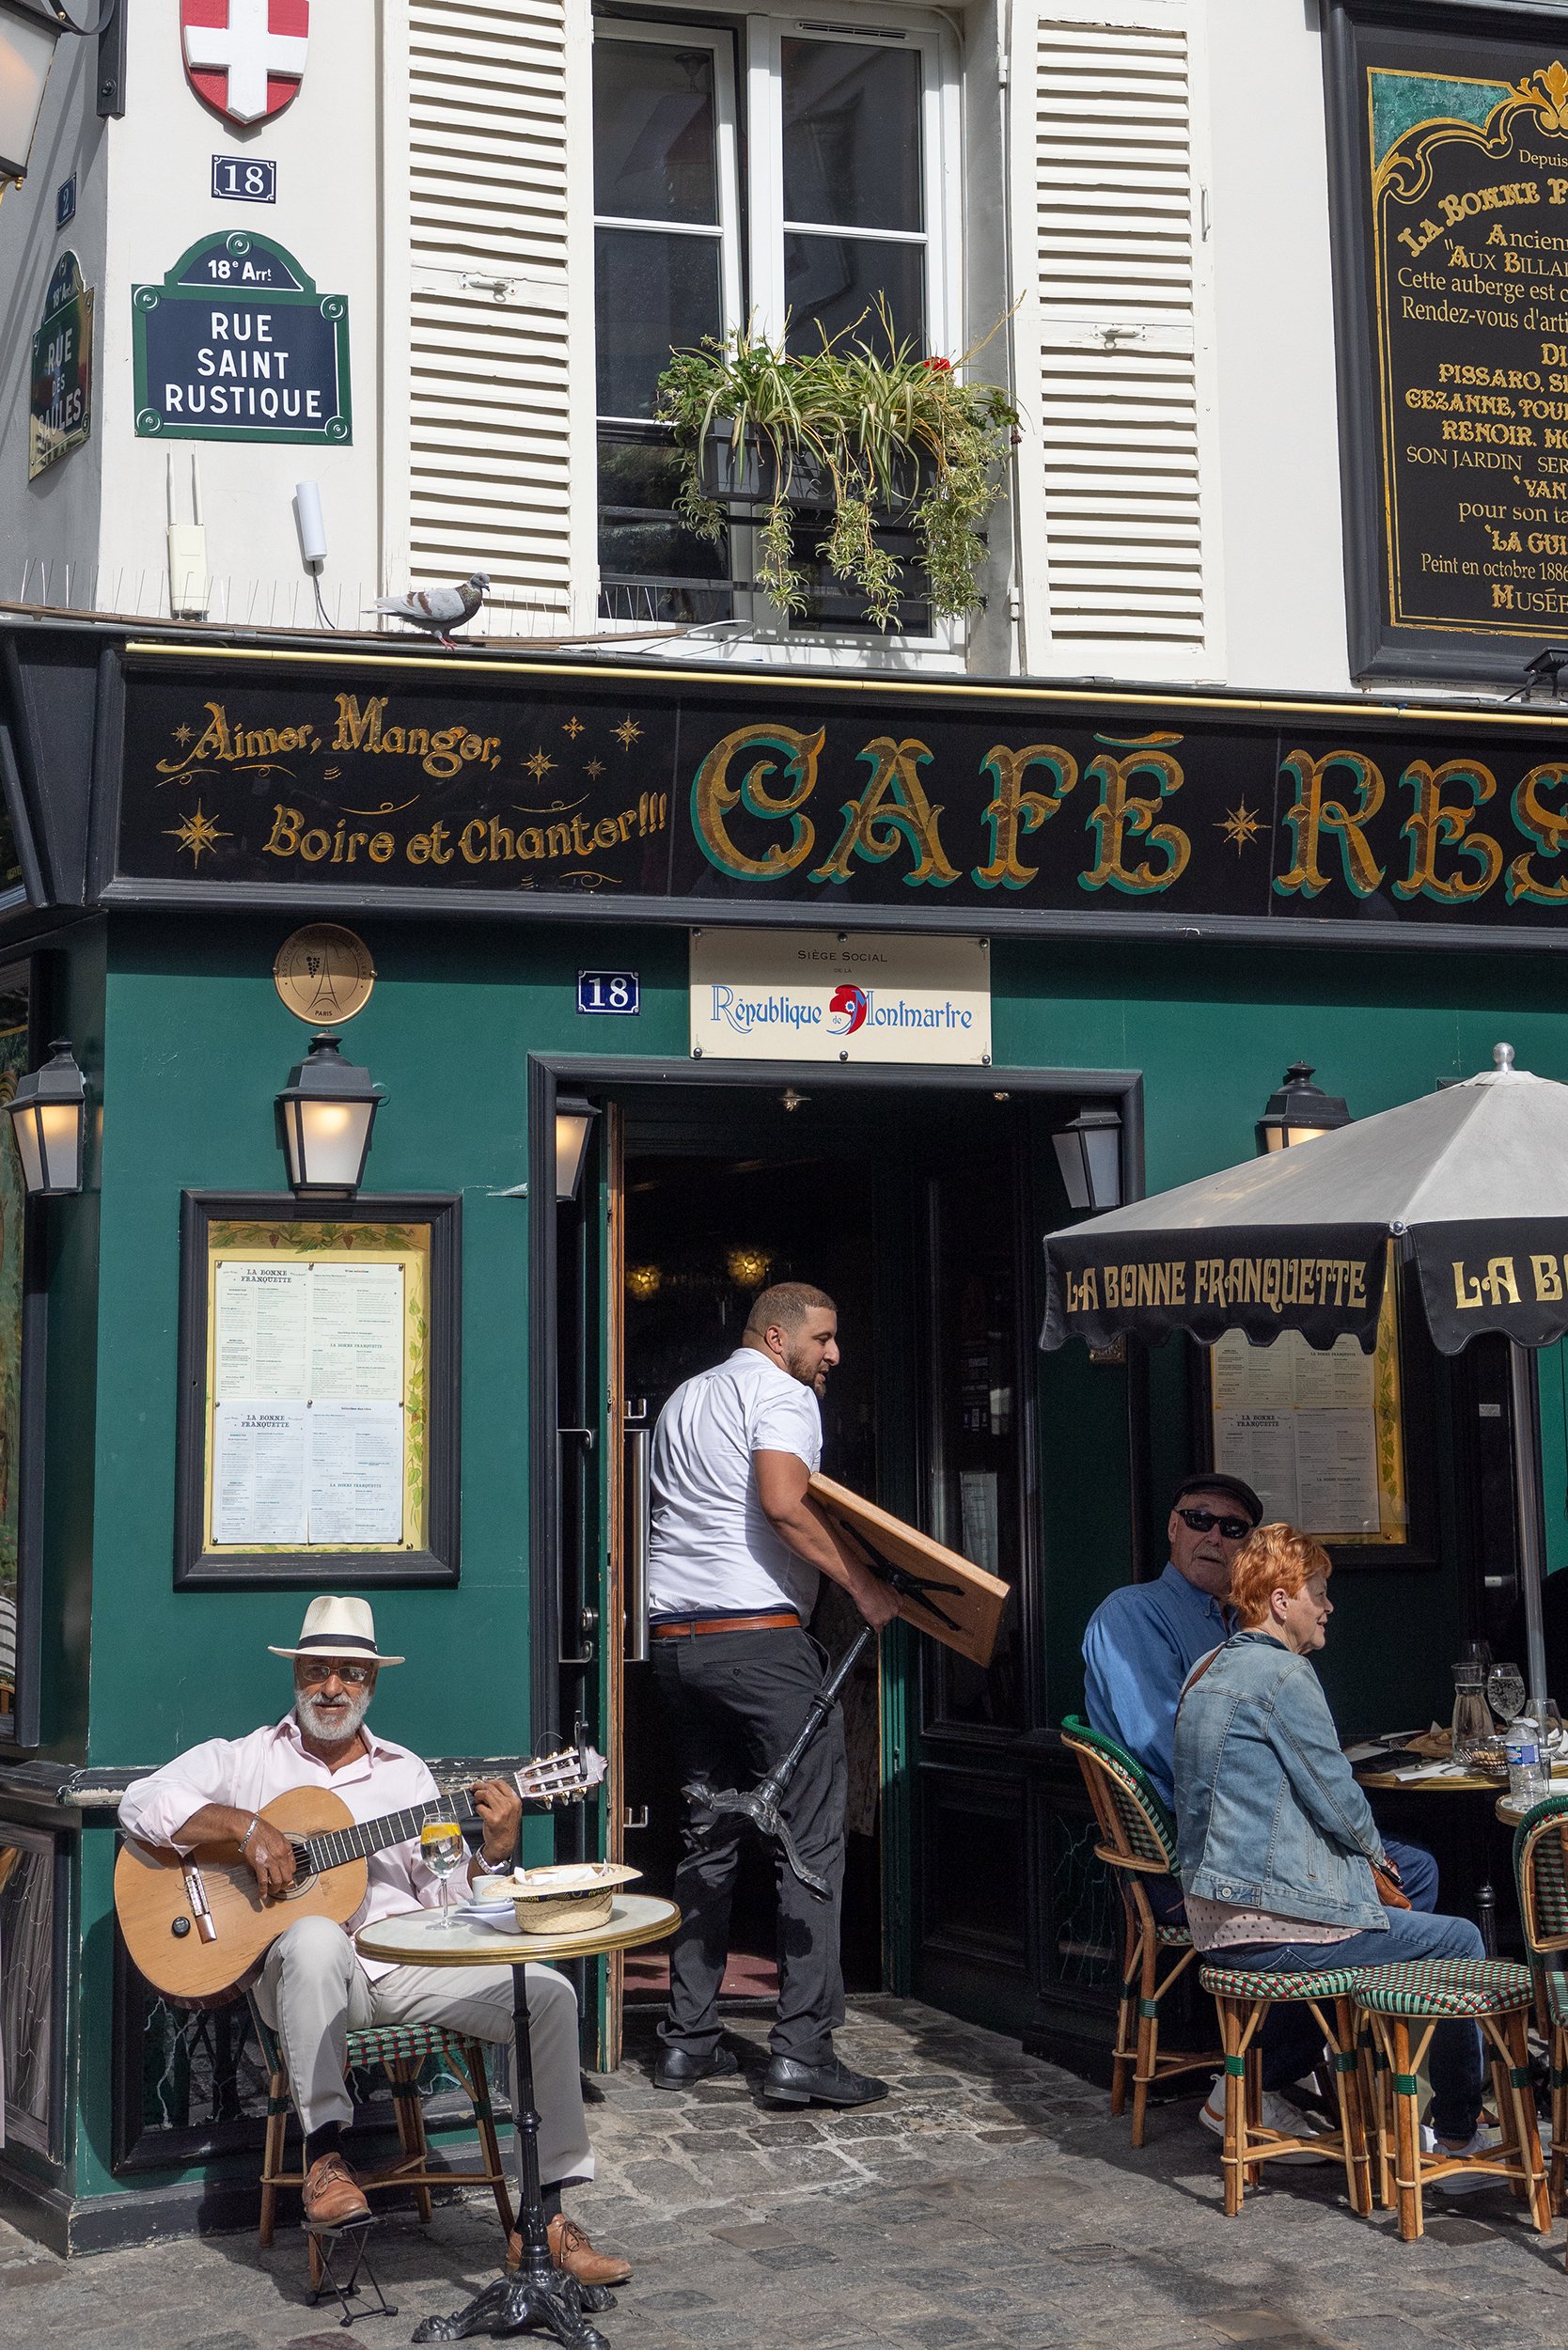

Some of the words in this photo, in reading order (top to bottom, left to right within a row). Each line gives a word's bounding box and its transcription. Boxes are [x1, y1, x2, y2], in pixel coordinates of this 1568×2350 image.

[1519, 149, 1568, 169] Depuis
[224, 164, 264, 195] 18
[61, 194, 70, 216] 2
[1397, 218, 1445, 258] LA
[1437, 181, 1541, 227] BONNE
[1485, 224, 1568, 252] Ancien
[1504, 251, 1568, 277] BILLA
[1397, 267, 1447, 290] Cette
[1451, 274, 1525, 305] auberge
[1529, 284, 1556, 302] est
[212, 311, 273, 342] RUE
[1402, 295, 1519, 329] Rendez-vous
[48, 327, 72, 376] RUE
[196, 347, 290, 380] SAINT
[52, 372, 65, 398] DES
[1438, 363, 1545, 393] PISSARO,
[38, 387, 81, 440] SAULES
[165, 383, 322, 419] RUSTIQUE
[1404, 387, 1516, 419] CEZANNE,
[1405, 445, 1448, 465] SON
[1451, 449, 1523, 471] JARDIN
[1458, 501, 1507, 523] pour
[1513, 506, 1549, 524] son
[1420, 552, 1459, 574] Peint
[1462, 560, 1480, 575] en
[1482, 559, 1537, 580] octobre
[1538, 561, 1568, 582] 1886
[155, 701, 322, 774] Aimer,
[331, 692, 503, 778] Manger,
[689, 722, 1192, 896] CAFÉ
[261, 804, 396, 865] Boire
[405, 819, 455, 866] et
[457, 791, 668, 866] Chanter!!!
[797, 948, 838, 962] SIÈGE
[841, 950, 888, 964] SOCIAL
[588, 977, 630, 1009] 18
[711, 985, 823, 1035] République
[826, 990, 973, 1035] Montmartre
[832, 1015, 842, 1025] de
[241, 1276, 292, 1284] FRANQUETTE
[1065, 1266, 1100, 1313] LA
[1103, 1261, 1187, 1309] BONNE
[1193, 1257, 1368, 1315] FRANQUETTE
[1451, 1256, 1522, 1309] LA
[241, 1420, 290, 1429] FRANQUETTE
